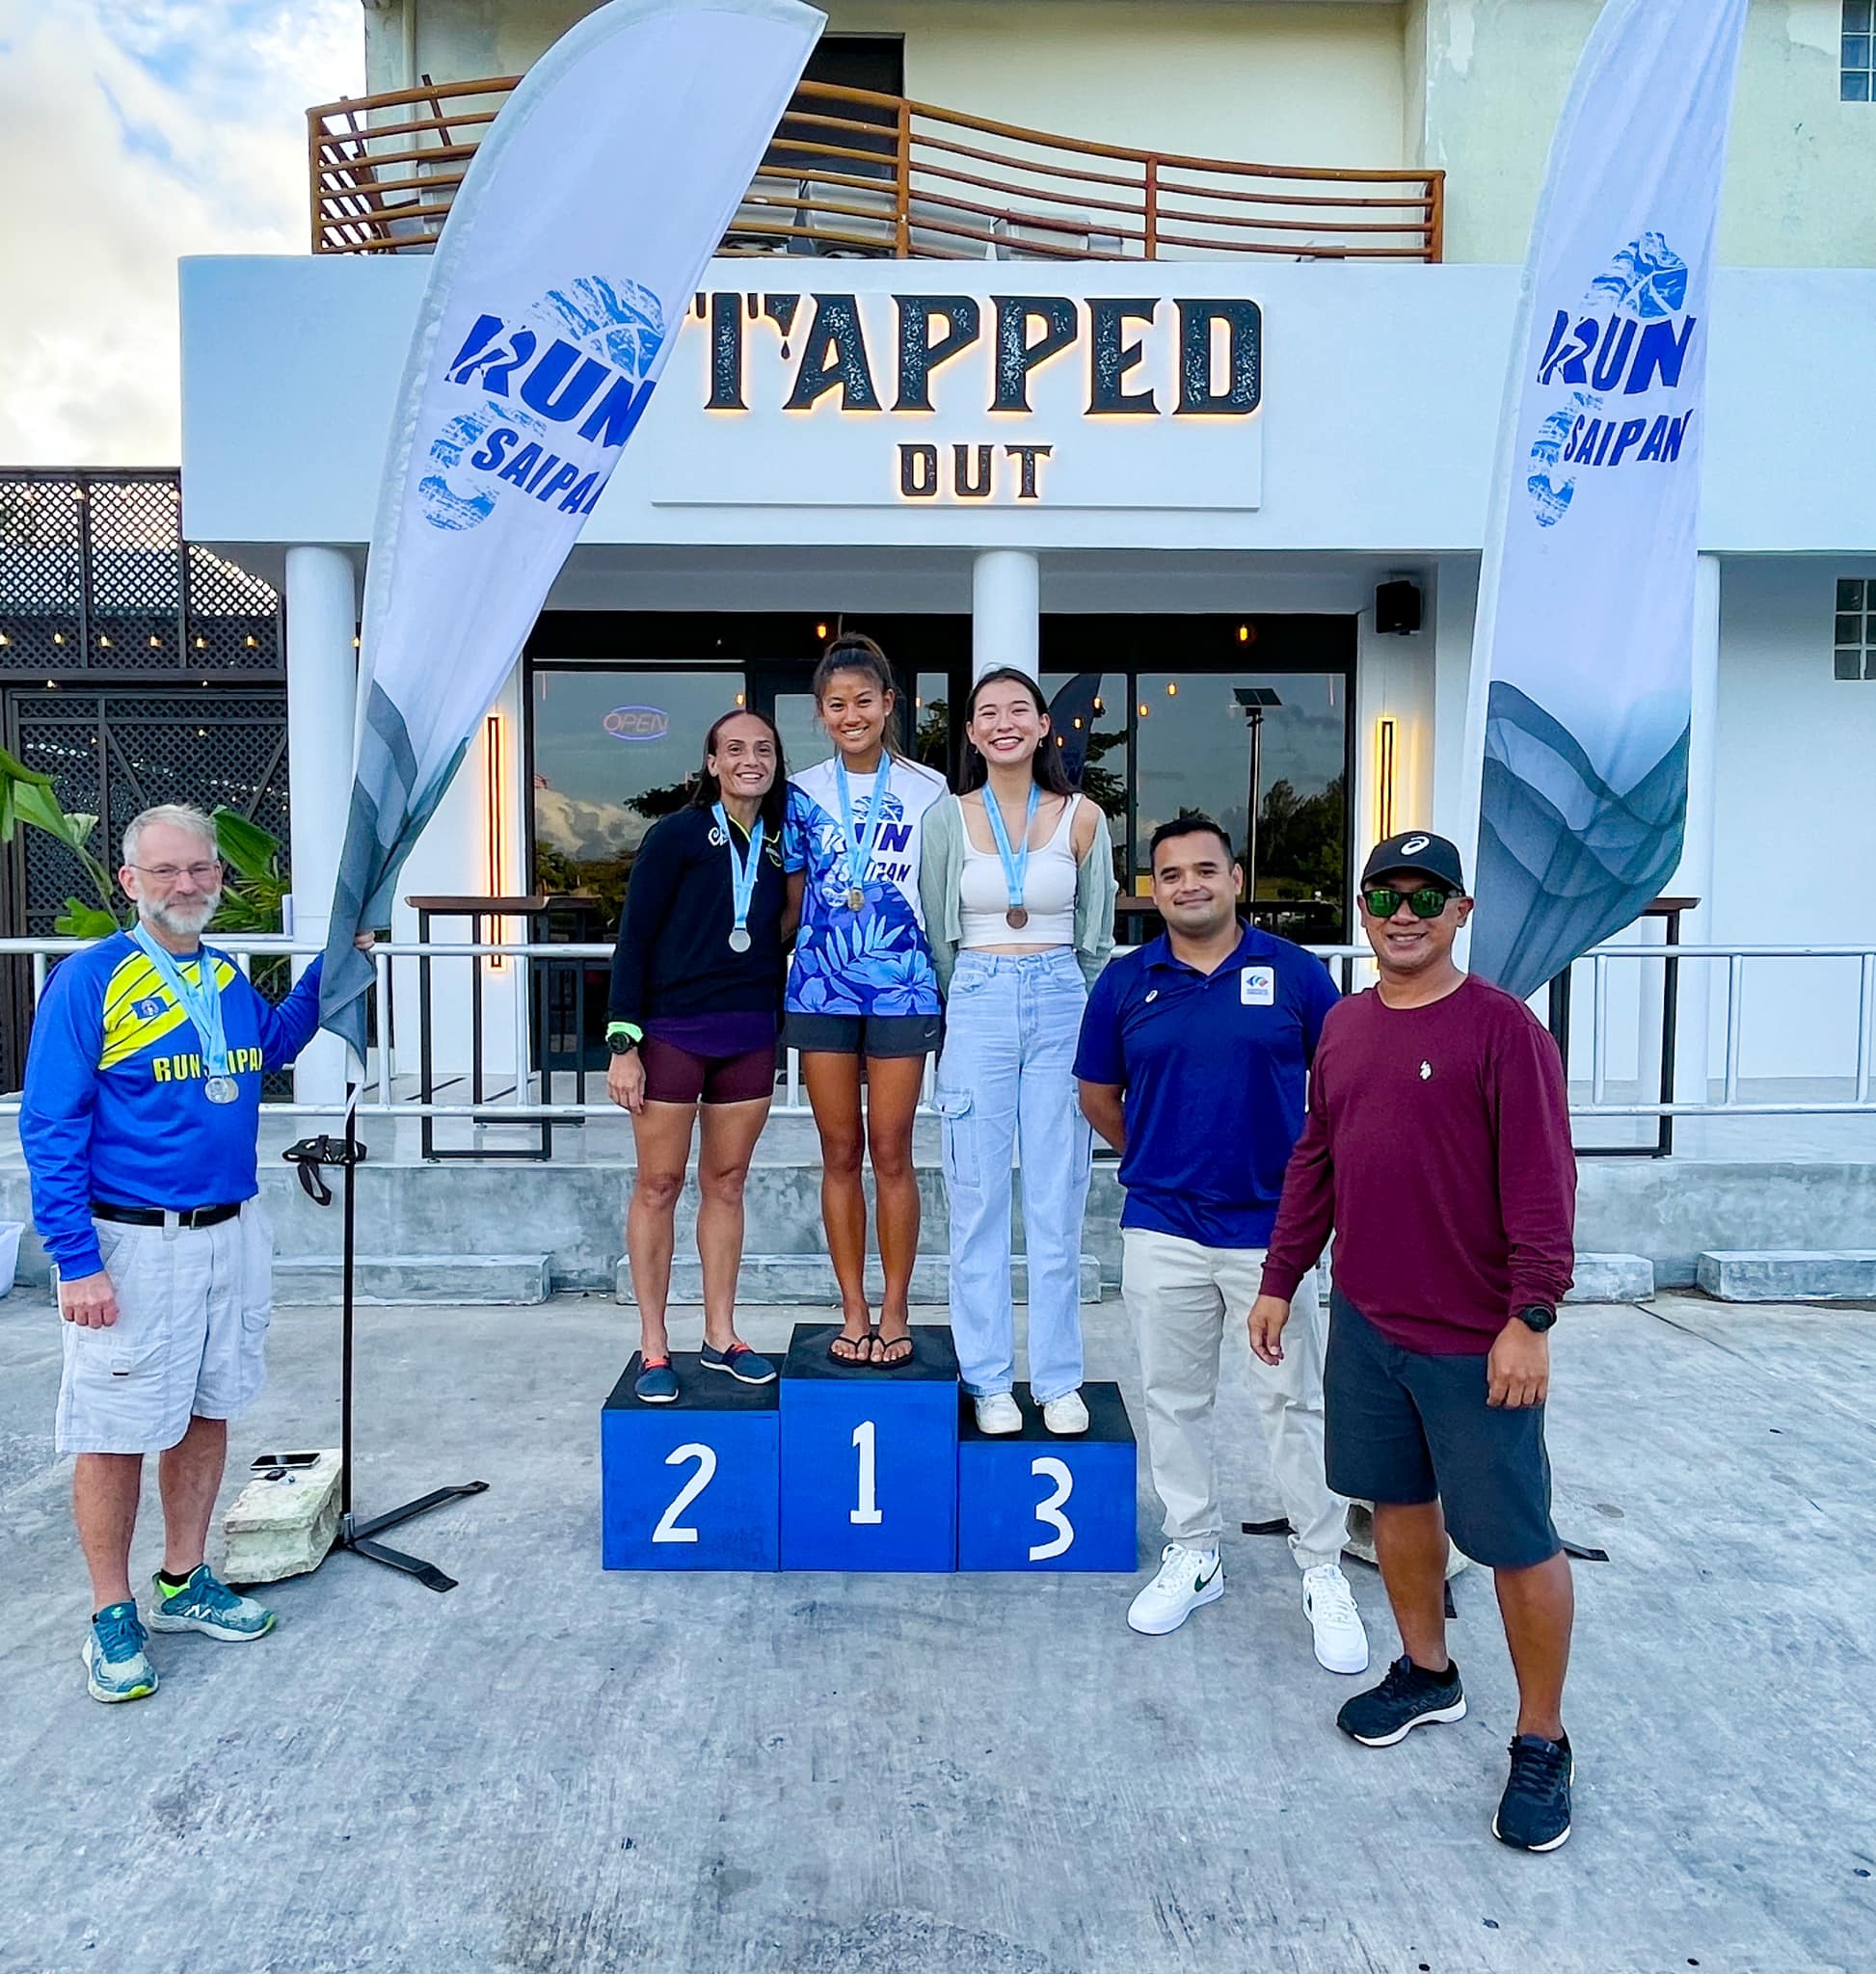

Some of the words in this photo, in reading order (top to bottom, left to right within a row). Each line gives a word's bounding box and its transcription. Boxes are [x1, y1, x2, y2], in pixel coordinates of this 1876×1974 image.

[444, 313, 657, 448] RUN
[685, 292, 1262, 415] TAPPED
[1537, 309, 1697, 395] RUN
[898, 443, 1053, 498] OUT
[1564, 409, 1695, 467] SAIPAN
[603, 713, 670, 733] OPEN
[152, 1054, 201, 1081] RUN
[652, 1443, 717, 1542] 2
[850, 1420, 883, 1524] 1
[1030, 1456, 1075, 1561] 3
